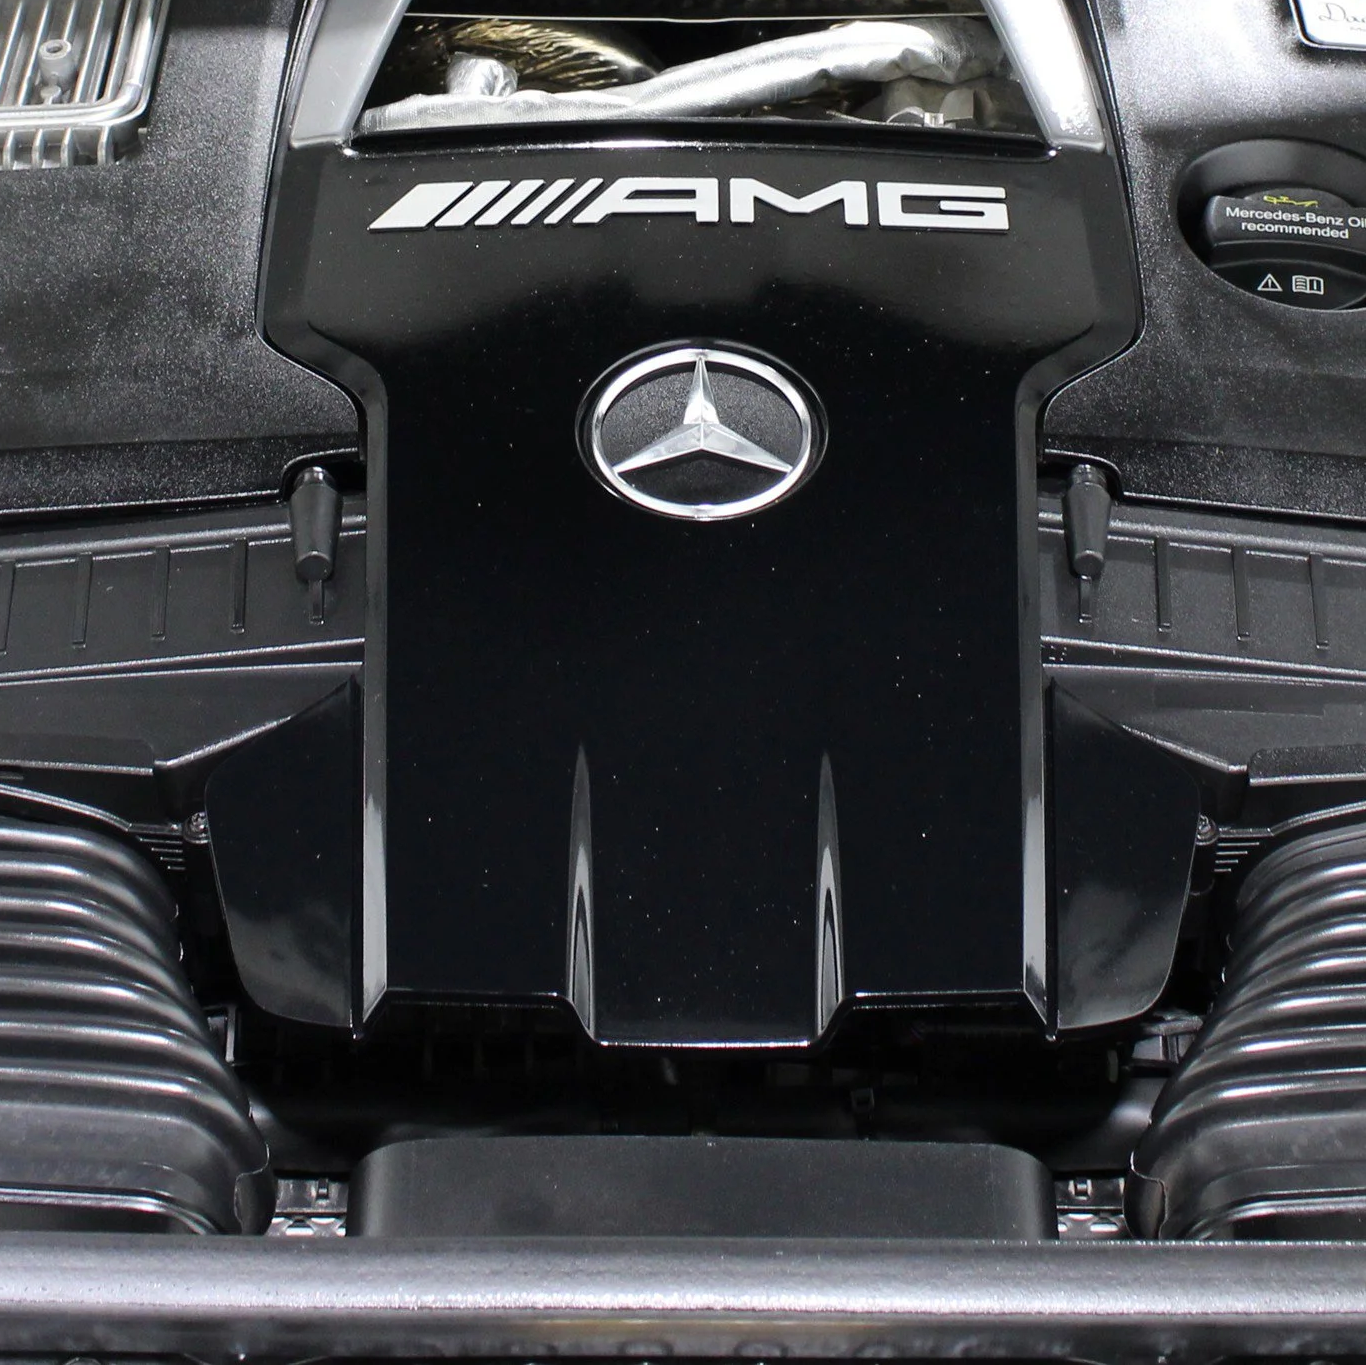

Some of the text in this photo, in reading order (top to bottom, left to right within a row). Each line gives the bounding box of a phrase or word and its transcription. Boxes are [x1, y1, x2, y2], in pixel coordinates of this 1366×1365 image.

[572, 177, 1010, 233] AMG
[1225, 206, 1344, 227] Mercedes-Benz
[1241, 221, 1349, 240] recommended
